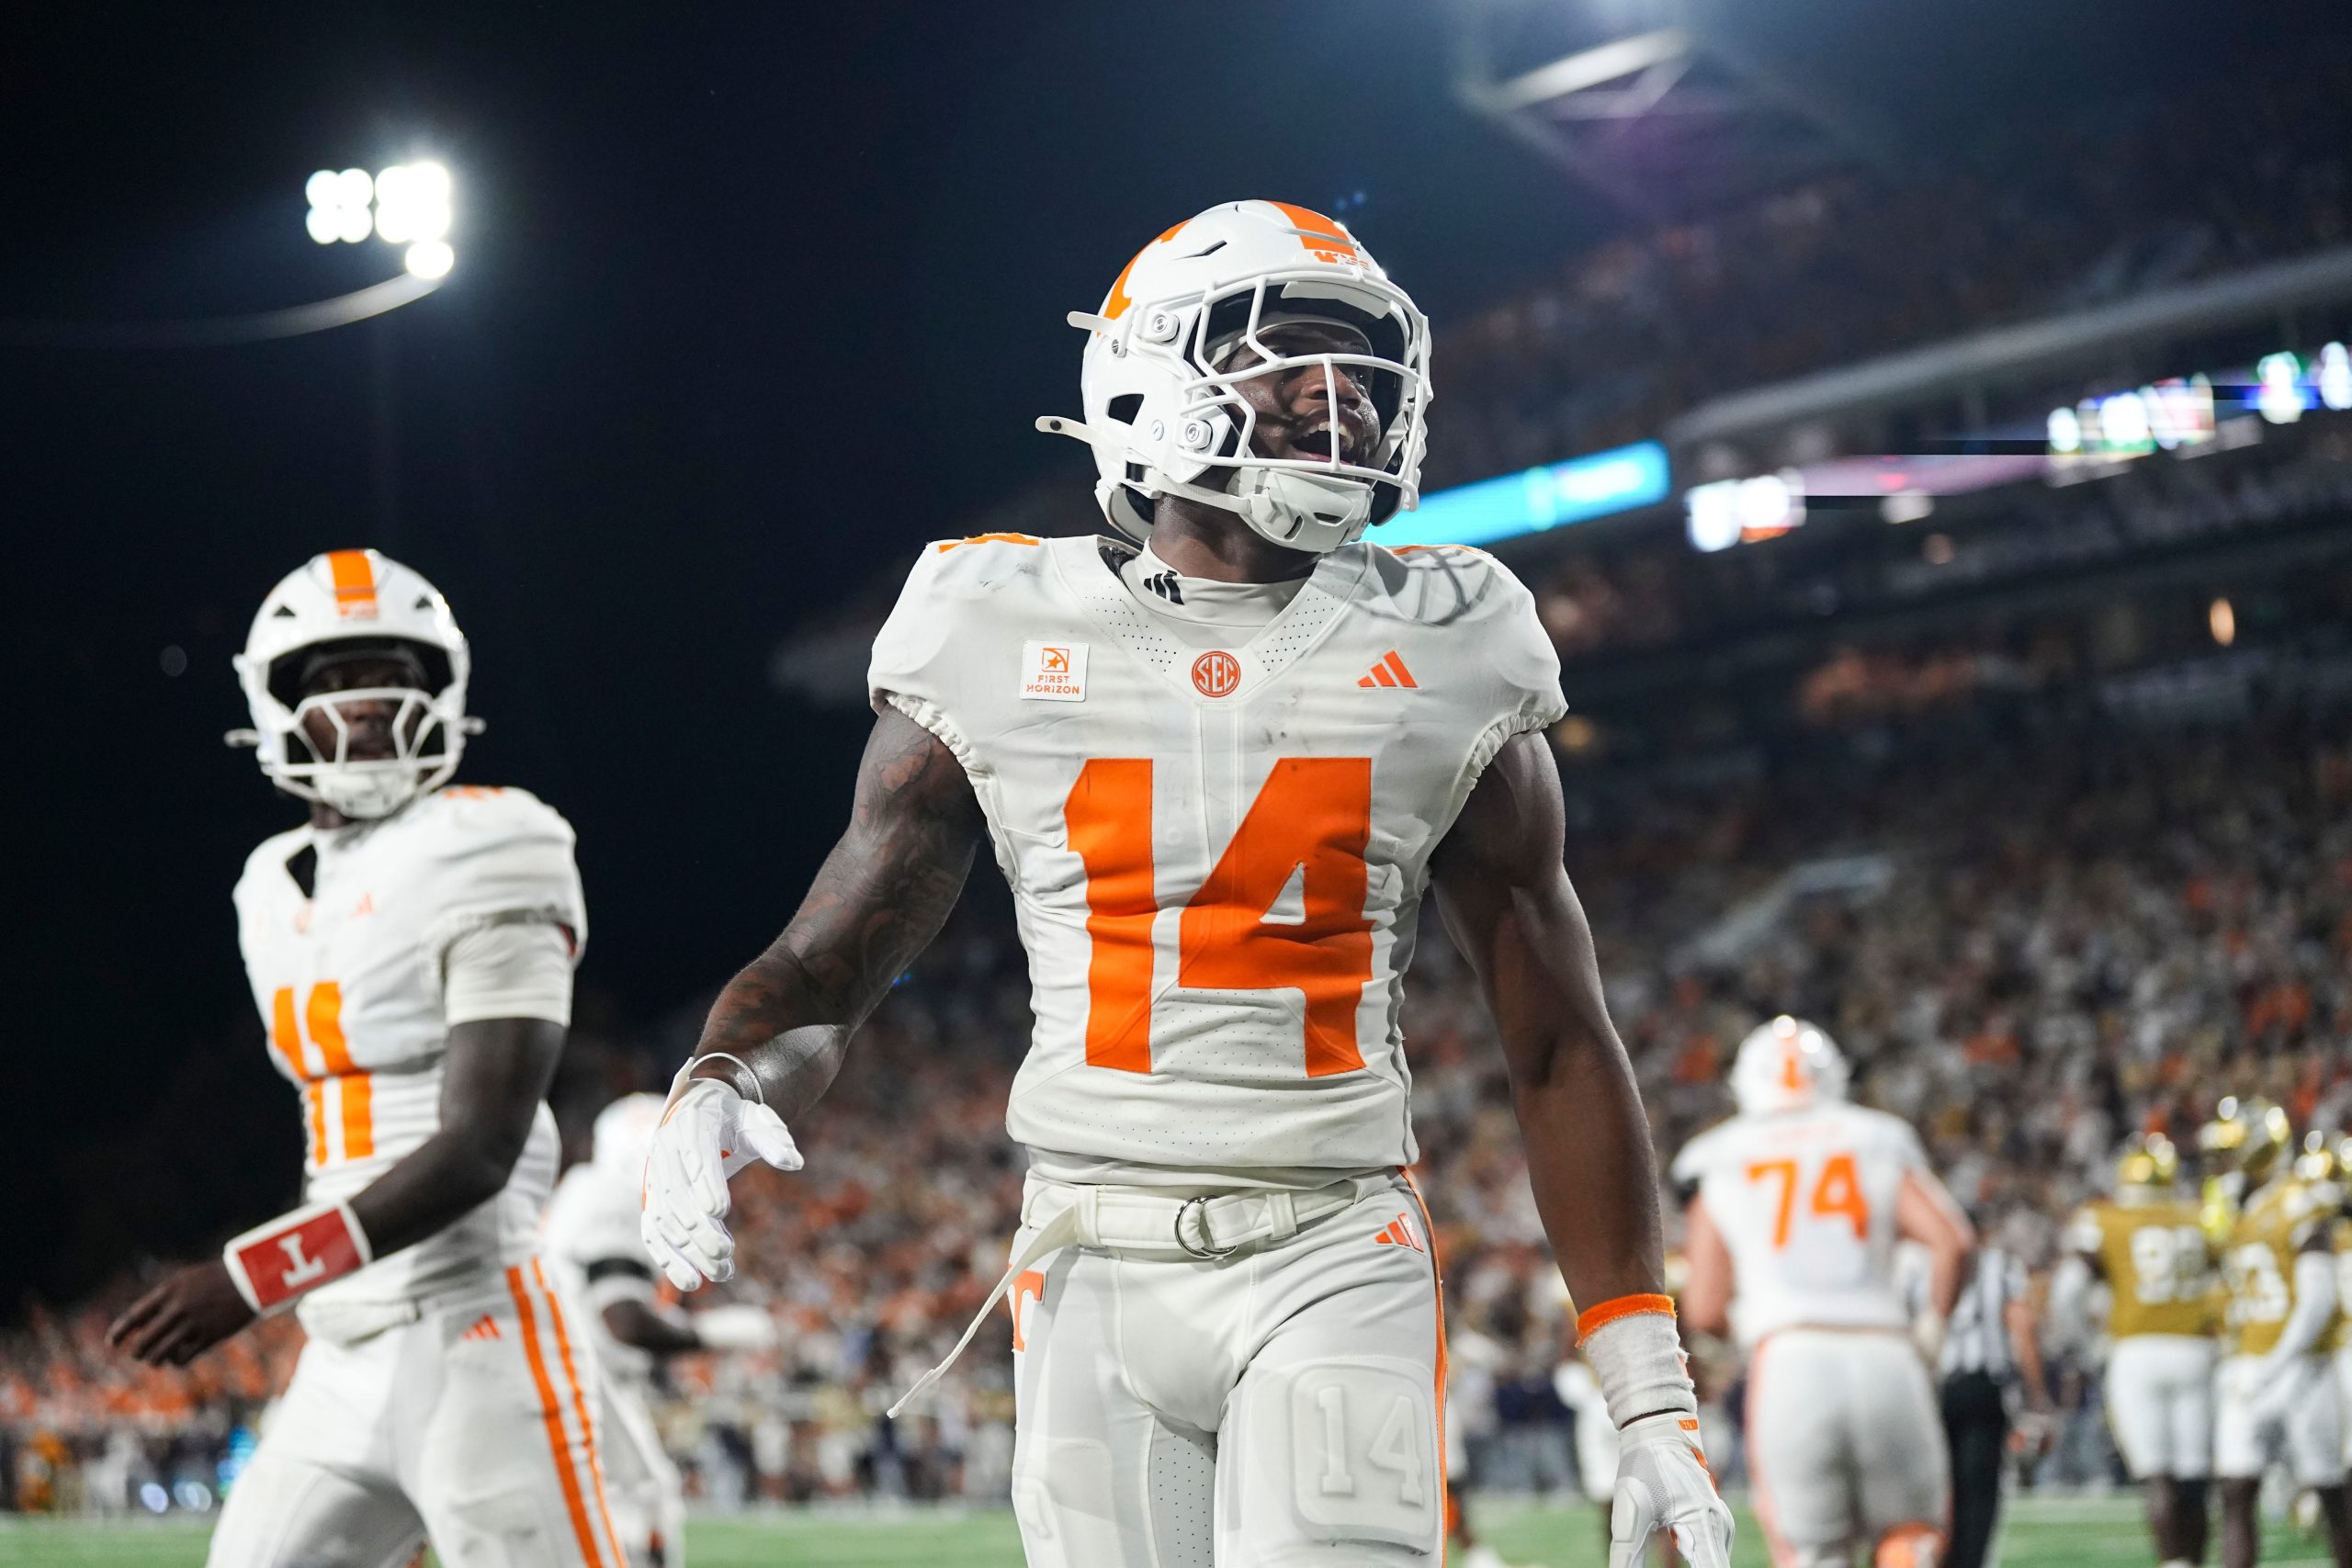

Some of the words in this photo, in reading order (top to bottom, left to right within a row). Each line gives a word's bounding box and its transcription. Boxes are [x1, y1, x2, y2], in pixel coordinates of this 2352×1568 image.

[1026, 684, 1080, 694] HORIZON
[1037, 675, 1070, 683] FIRST
[1196, 655, 1236, 693] SEC
[1063, 757, 1376, 1078] 14
[273, 981, 375, 1167] 11
[1746, 1155, 1869, 1249] 74
[1317, 1385, 1424, 1509] 14
